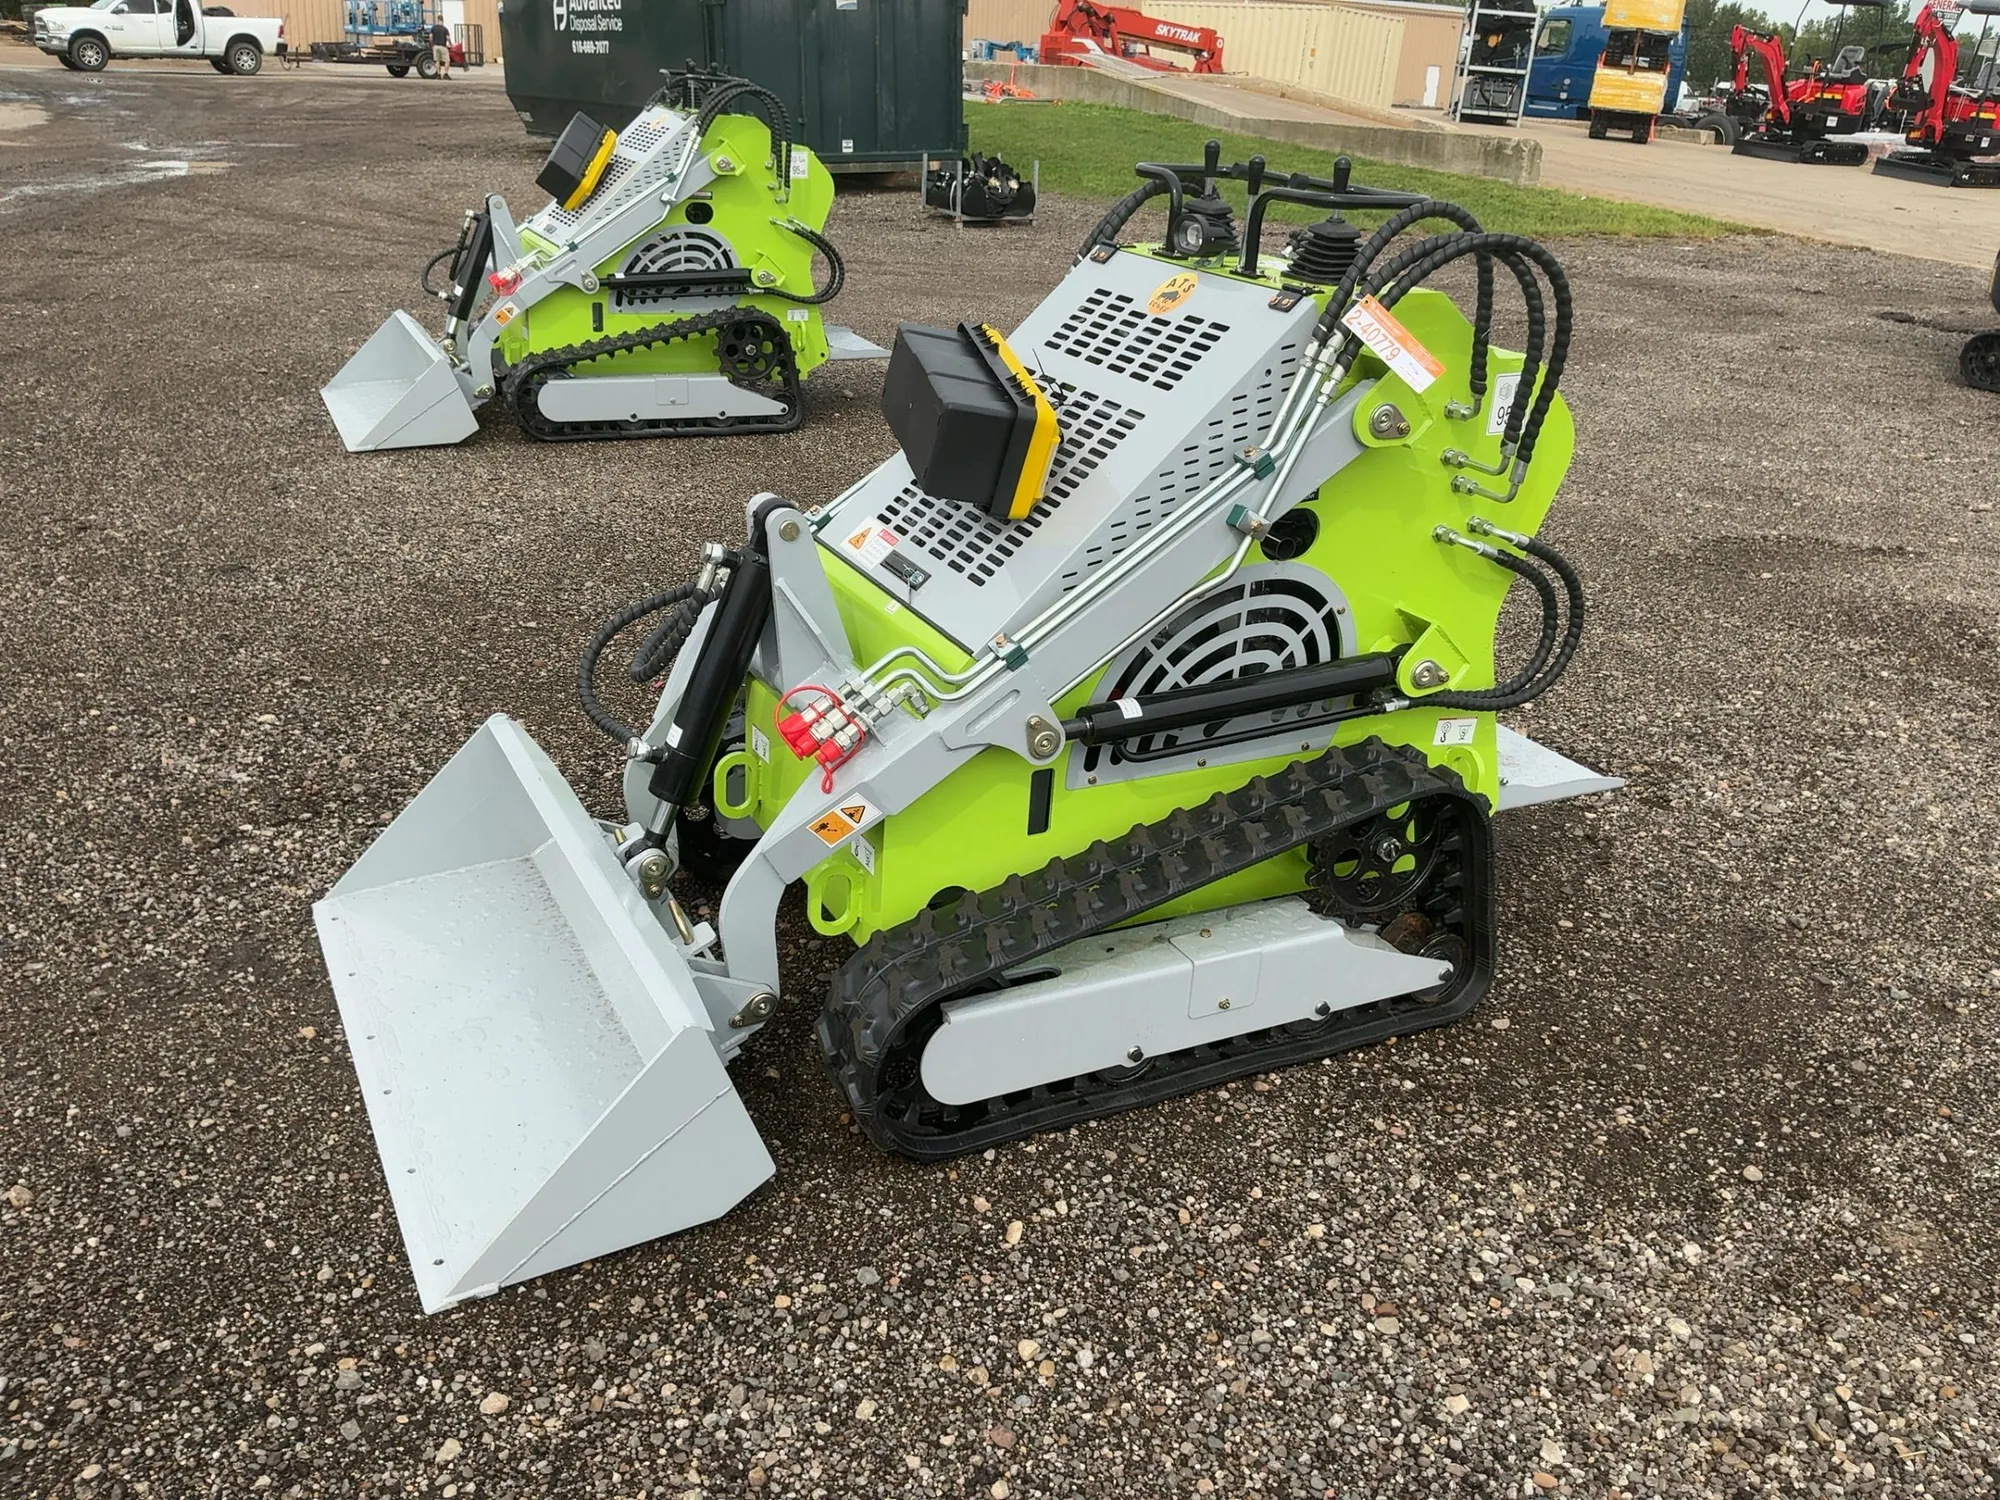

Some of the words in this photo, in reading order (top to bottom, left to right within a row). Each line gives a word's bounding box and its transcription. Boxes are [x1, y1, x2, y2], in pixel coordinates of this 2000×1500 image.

[569, 14, 597, 34] Disposal
[597, 13, 623, 31] Service
[1155, 24, 1201, 43] SKYTRAK
[1166, 278, 1195, 293] ATS
[1345, 309, 1401, 361] 2-40779
